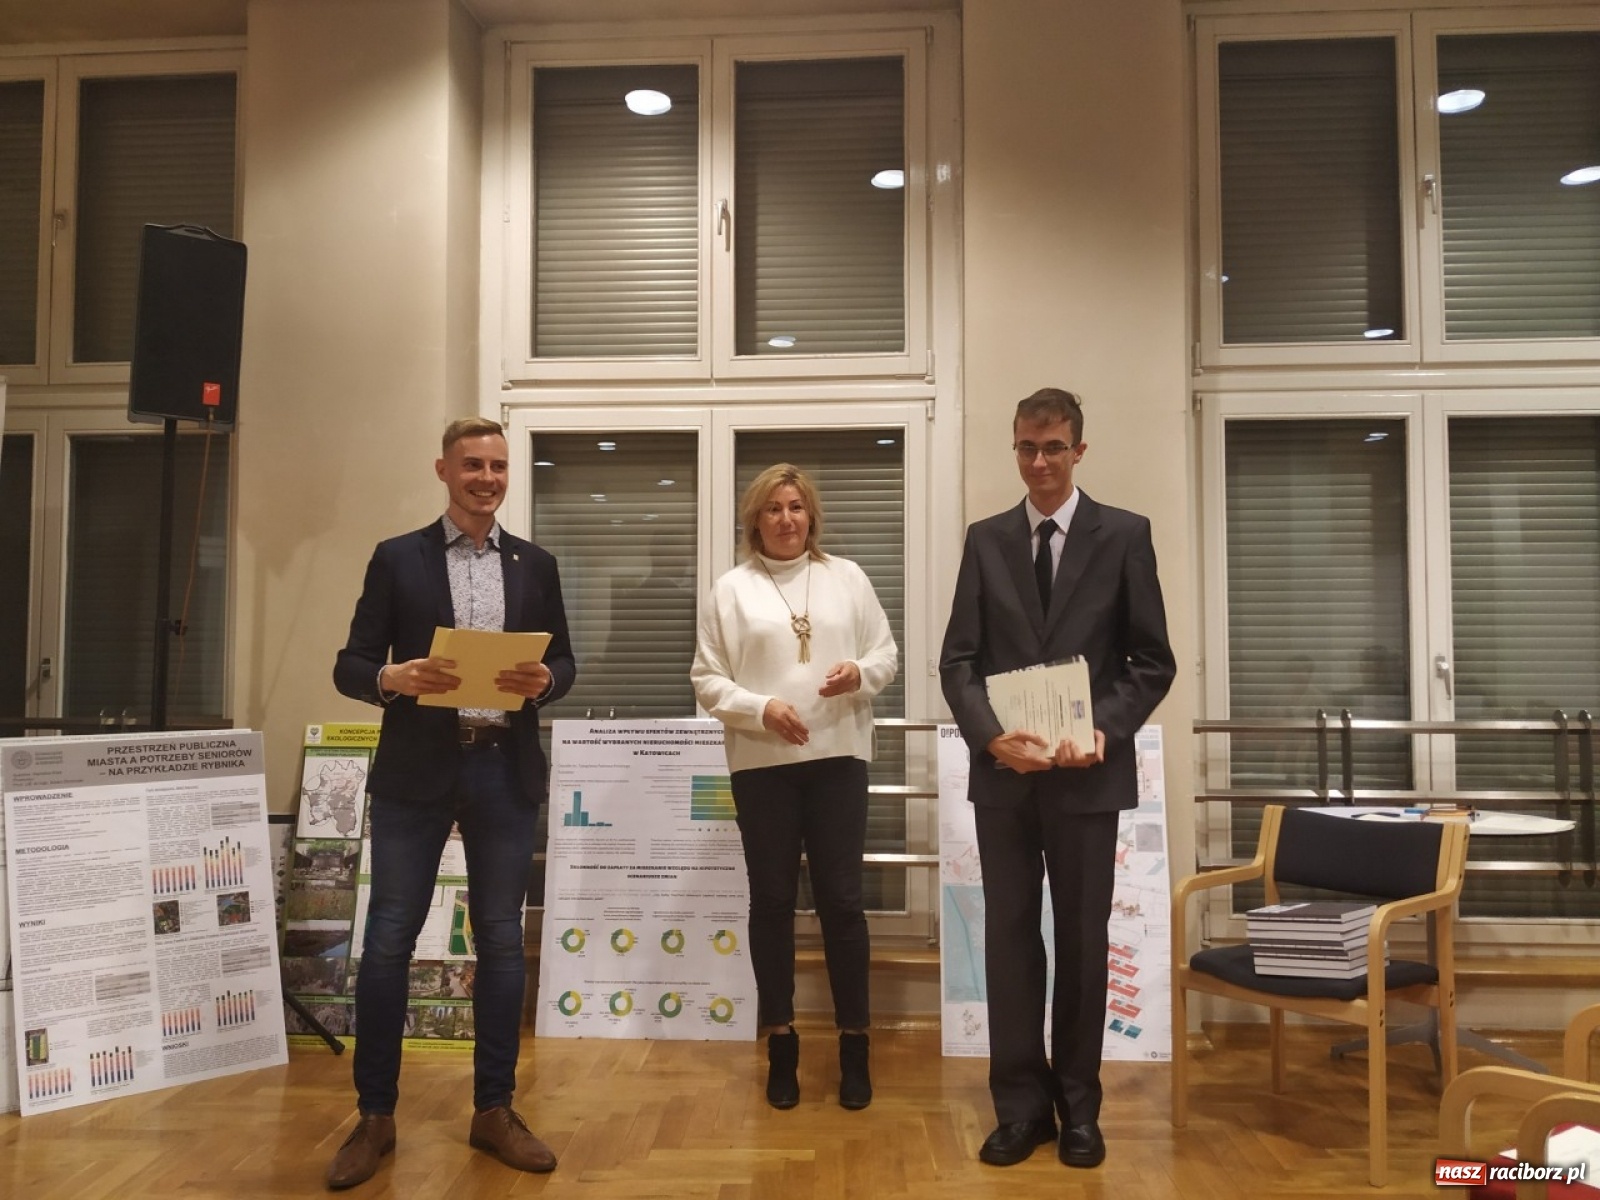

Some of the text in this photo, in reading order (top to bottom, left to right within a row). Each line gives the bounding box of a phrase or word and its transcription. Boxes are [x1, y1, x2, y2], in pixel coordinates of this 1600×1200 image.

[107, 740, 237, 755] PRZESTRZEŃ PUBLICZNA
[87, 748, 252, 767] MIASTA A POTRZEBY SENIORÓW
[108, 767, 124, 776] NA
[126, 763, 199, 775] PRZYKŁADZIE
[200, 759, 246, 770] RYBNIKA
[13, 791, 73, 802] WPROWADZENIE
[15, 844, 70, 855] METODOLOGIA
[18, 919, 46, 929] WYNIKI
